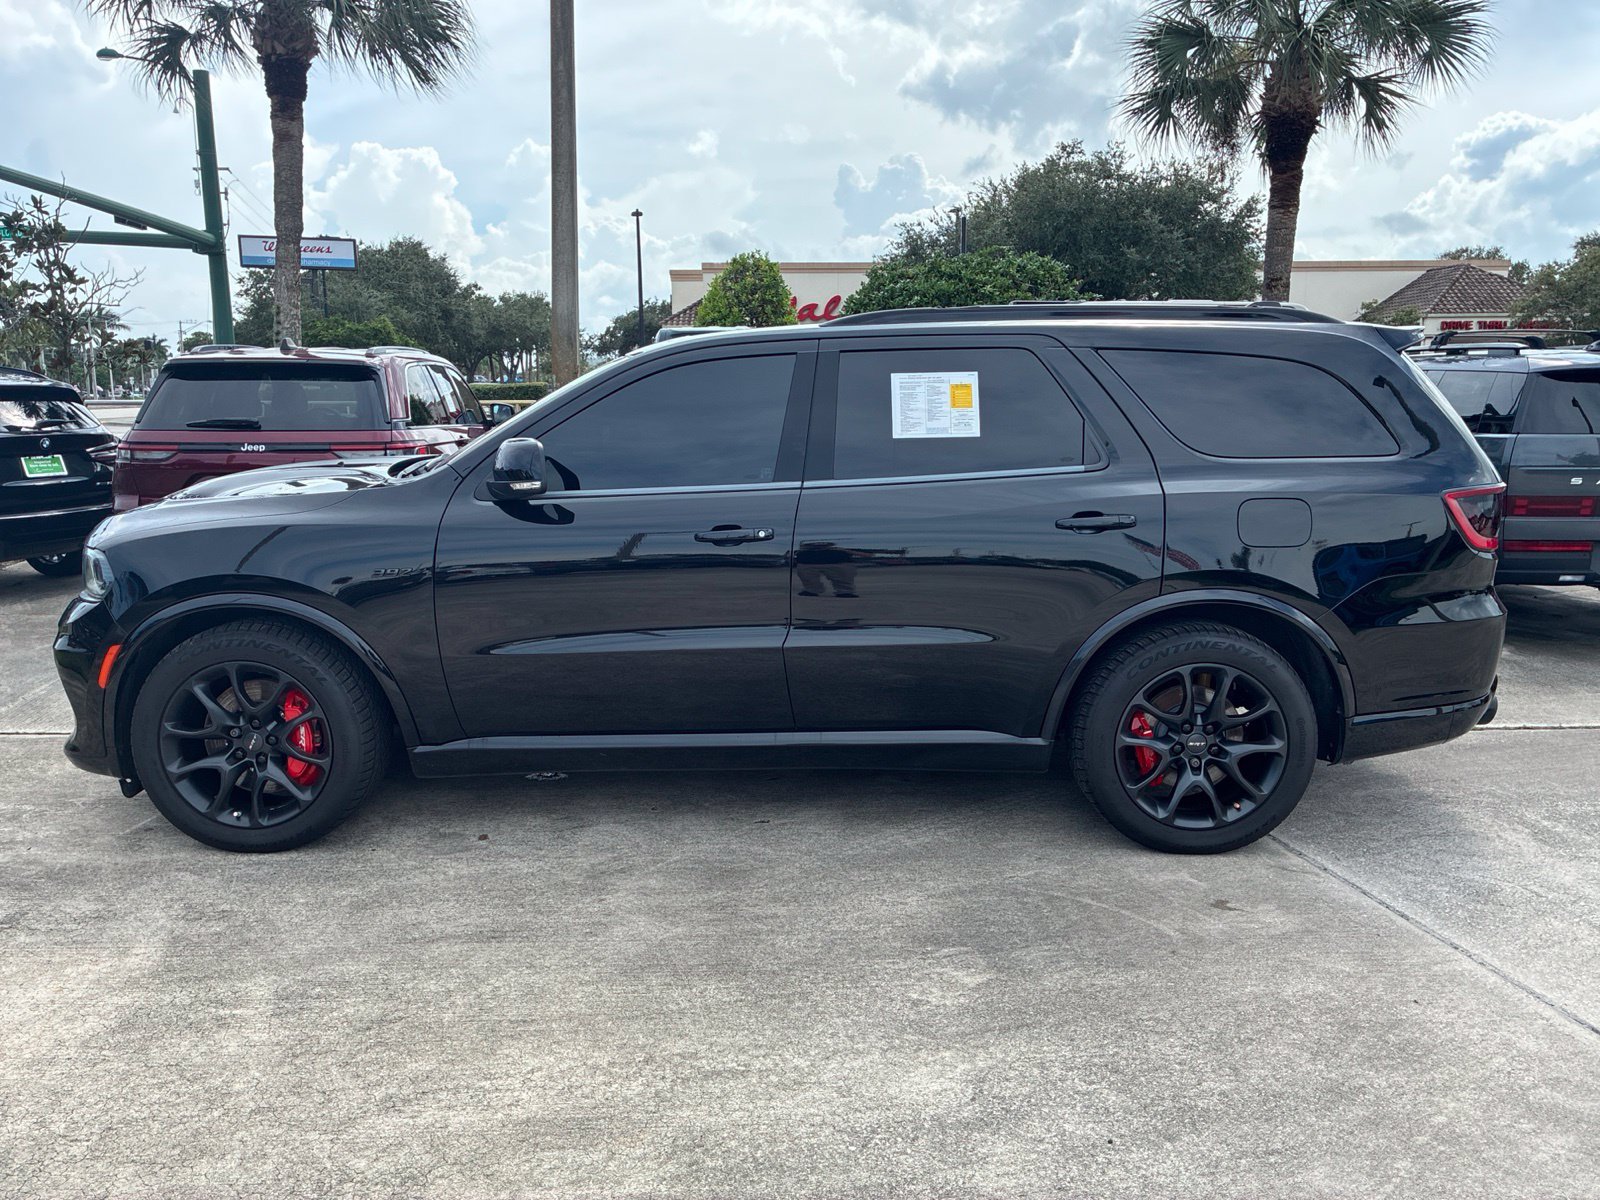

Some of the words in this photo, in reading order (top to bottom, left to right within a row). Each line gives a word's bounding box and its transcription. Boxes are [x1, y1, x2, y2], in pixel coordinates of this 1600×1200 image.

[302, 258, 331, 266] harmacy
[1440, 320, 1473, 331] DRIVE
[1477, 320, 1508, 330] THRU
[240, 443, 266, 452] Jeep
[1127, 640, 1278, 681] CONTINENTAL
